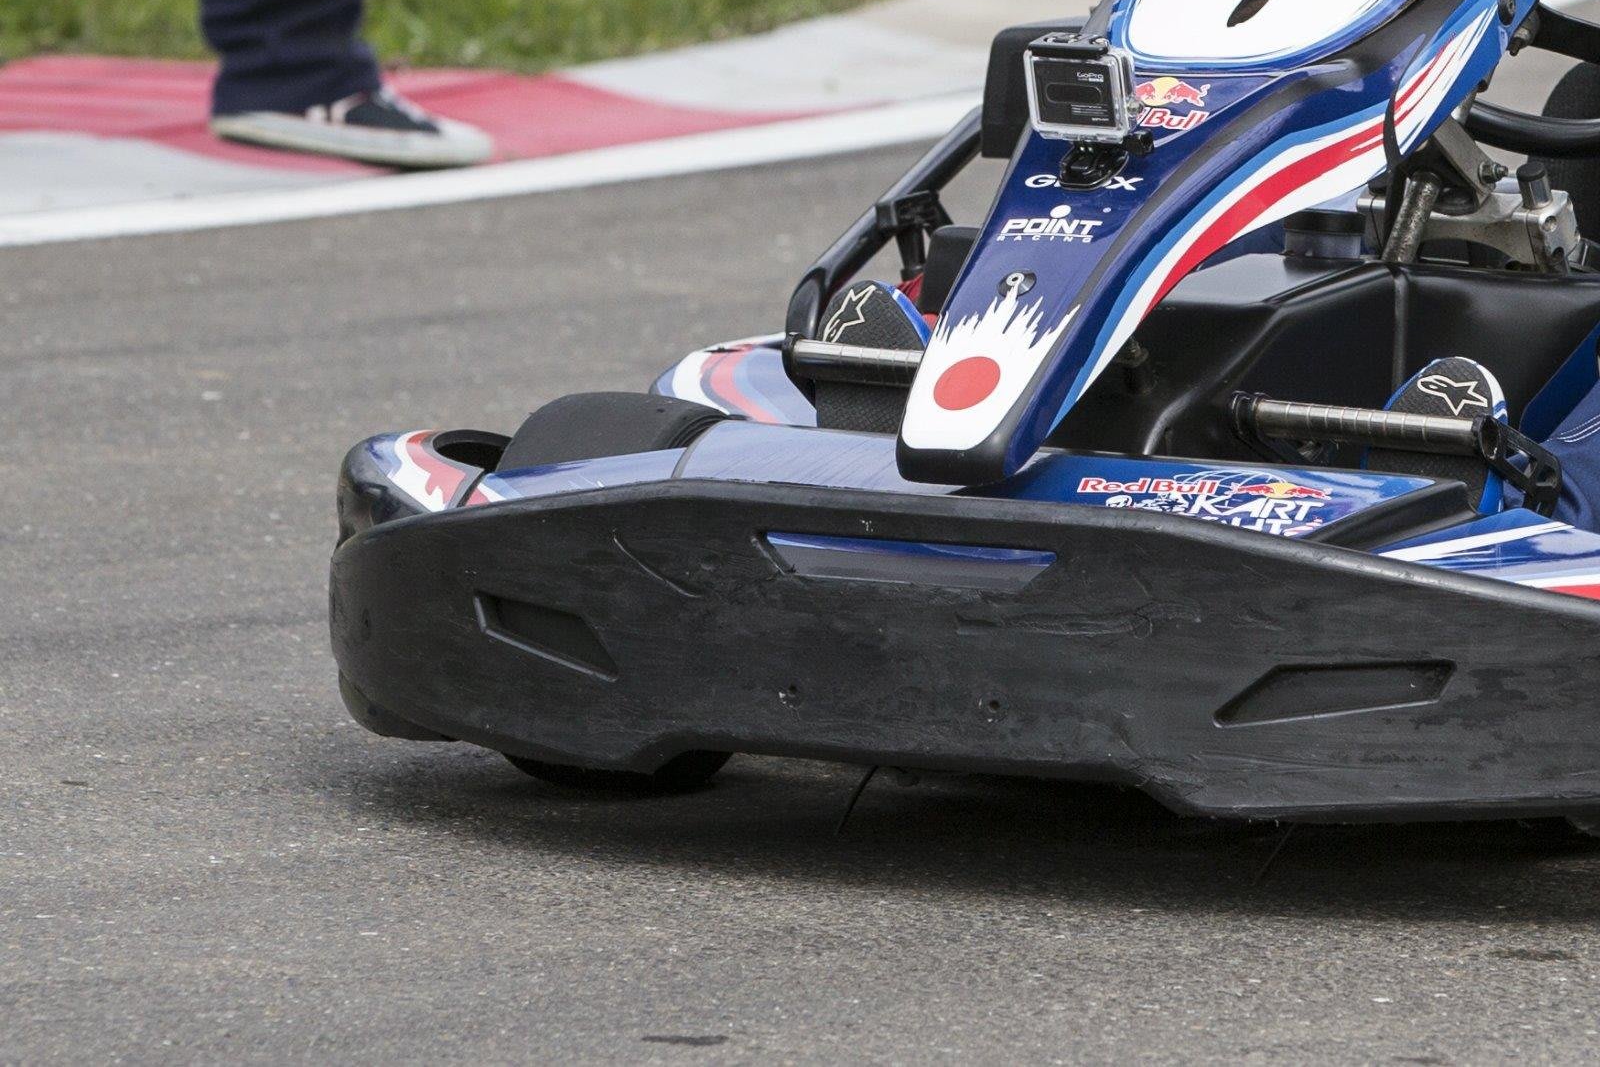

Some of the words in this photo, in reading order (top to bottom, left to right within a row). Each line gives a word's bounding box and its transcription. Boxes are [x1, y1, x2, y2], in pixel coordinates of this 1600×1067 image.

[1076, 71, 1104, 80] GoPro
[1147, 108, 1208, 129] Bull
[1025, 174, 1144, 190] GX
[1001, 205, 1103, 236] POINT
[996, 235, 1093, 243] RACING
[1077, 477, 1148, 493] Red
[1150, 478, 1220, 494] Bull
[1190, 494, 1324, 521] KART
